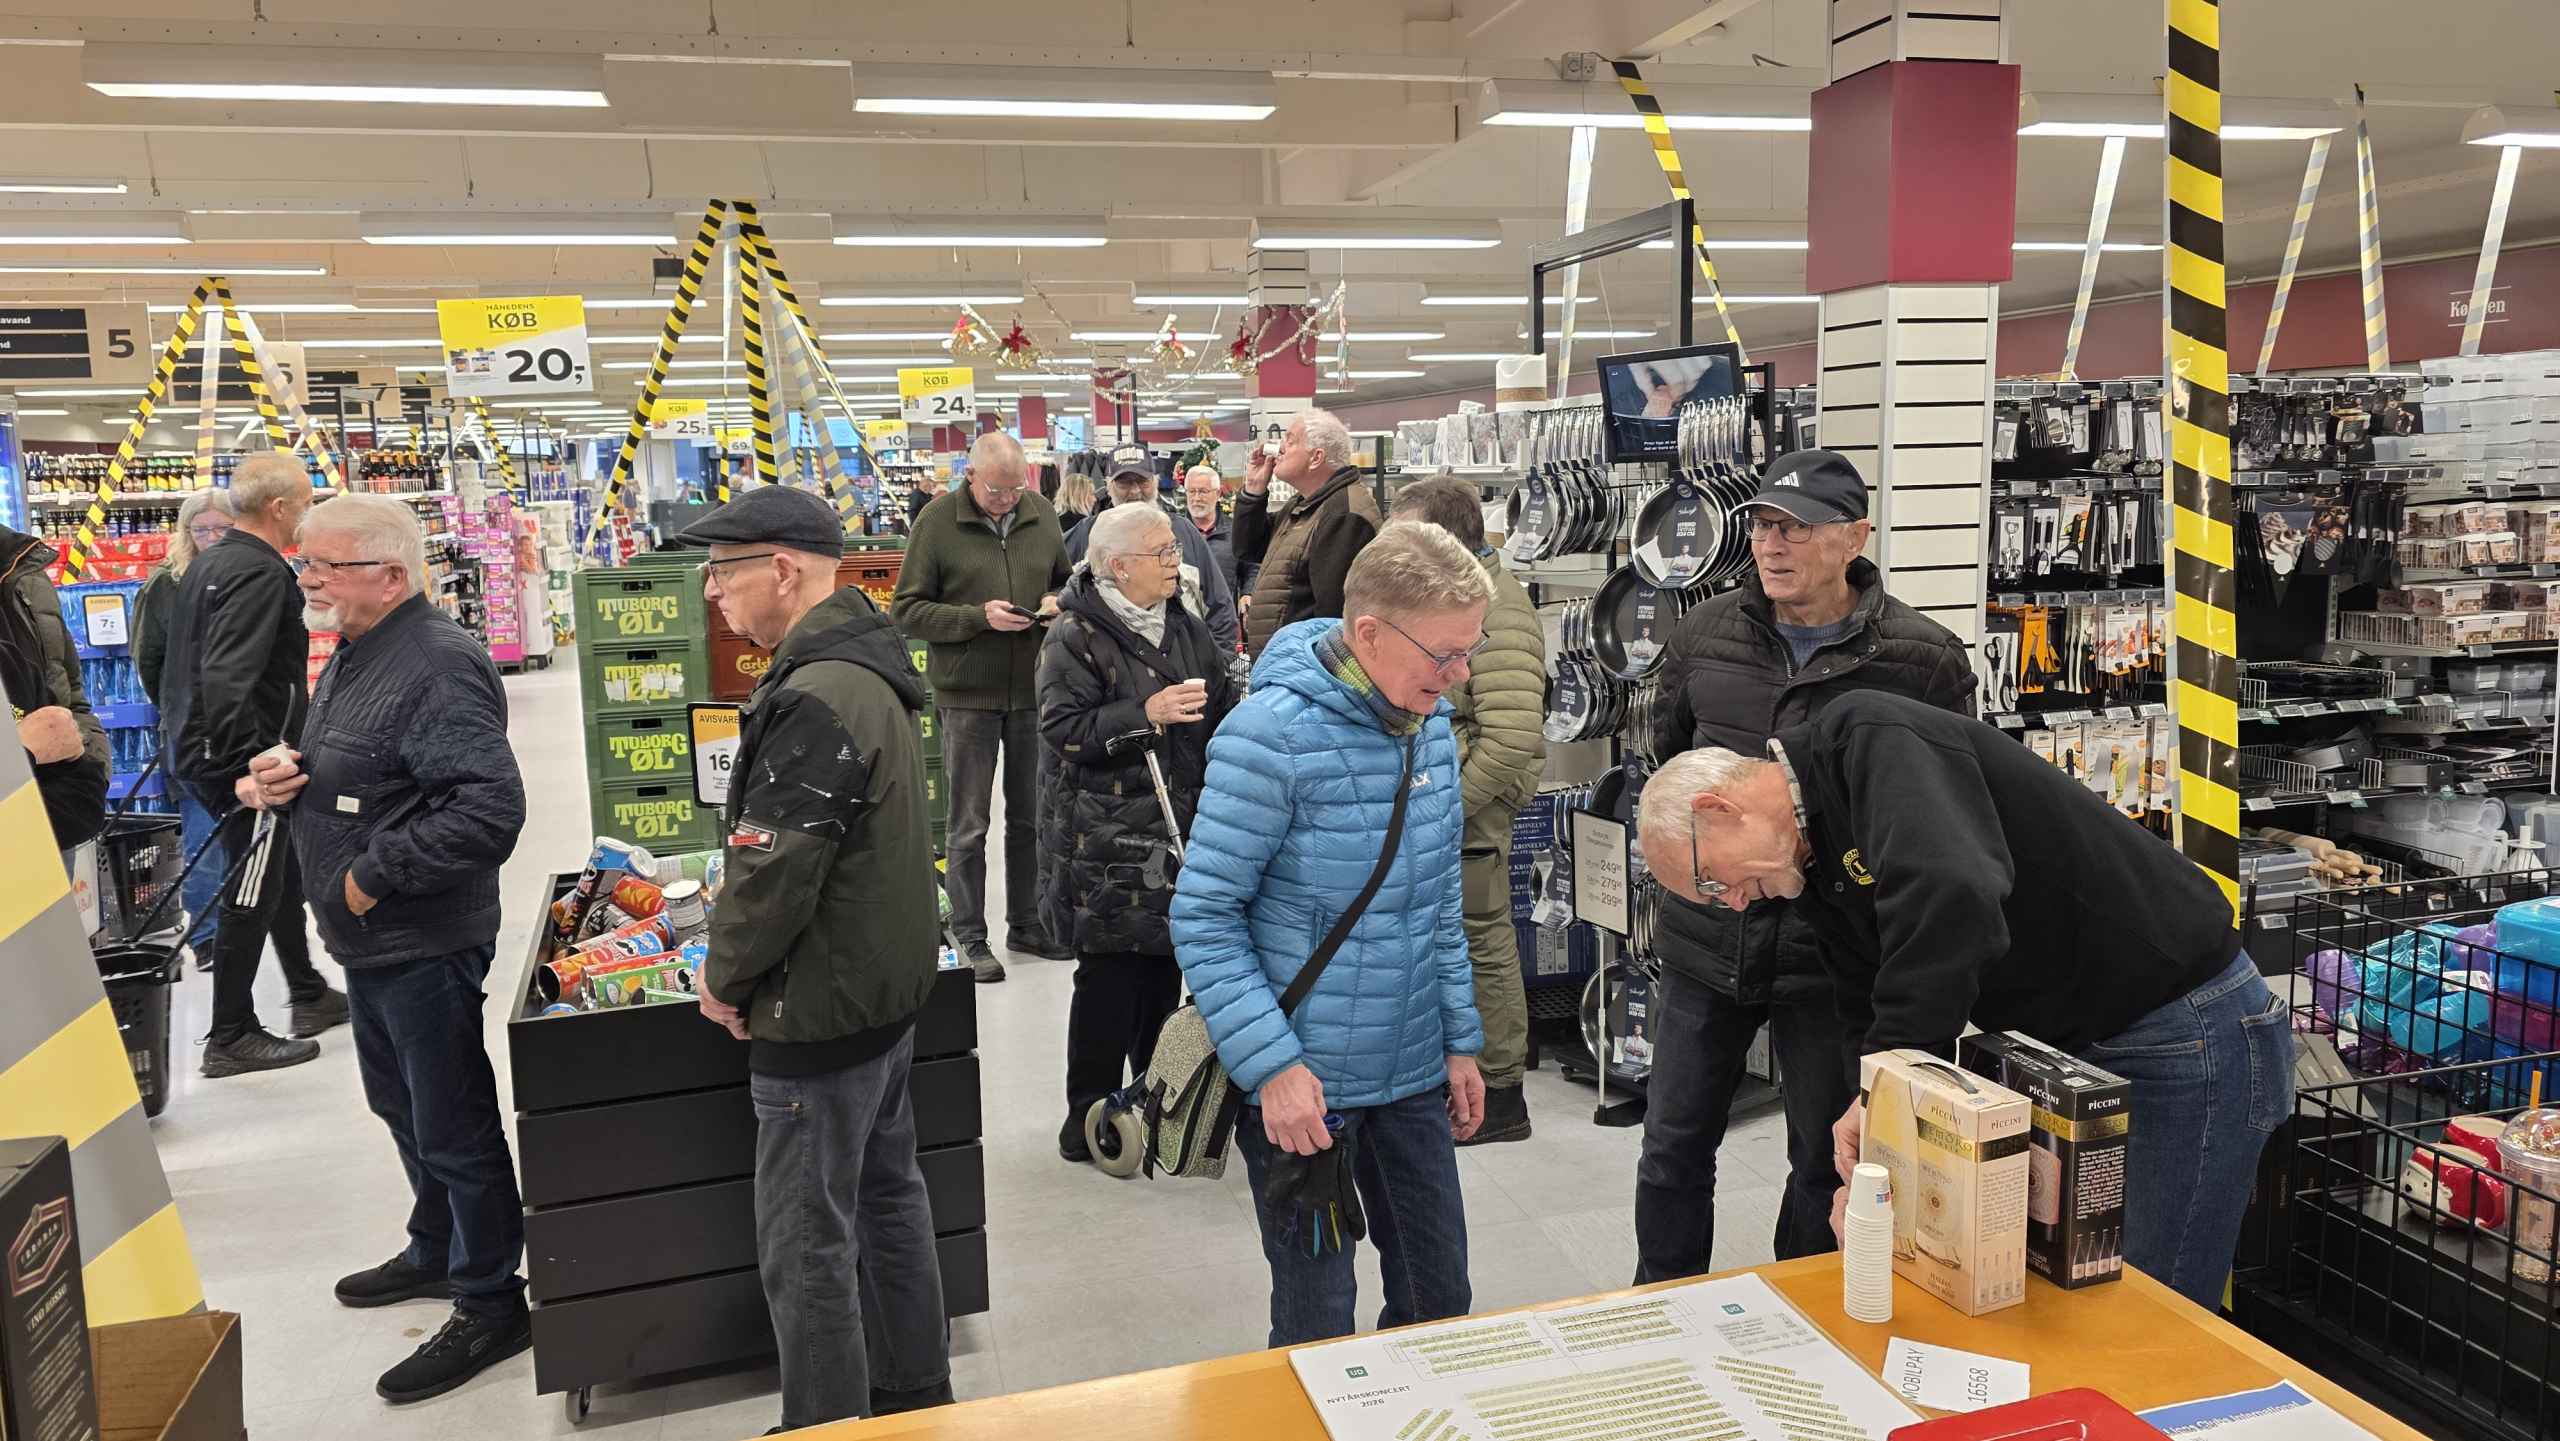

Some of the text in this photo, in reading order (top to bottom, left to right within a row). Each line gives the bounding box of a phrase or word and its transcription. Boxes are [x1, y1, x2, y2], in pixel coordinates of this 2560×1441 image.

[488, 312, 538, 329] KØB
[2449, 299, 2506, 318] Køen
[108, 329, 135, 358] 5
[597, 595, 679, 621] TUBORG
[618, 610, 665, 635] ØL
[609, 732, 689, 759] TUBORG
[629, 748, 675, 772] ØL
[709, 752, 731, 771] 16
[614, 799, 693, 826] TUBORG
[634, 814, 680, 839] ØL
[1327, 1385, 1411, 1404] NYTÅRSKONCERT
[1967, 1367, 1989, 1404] 16568
[2229, 1400, 2299, 1422] International
